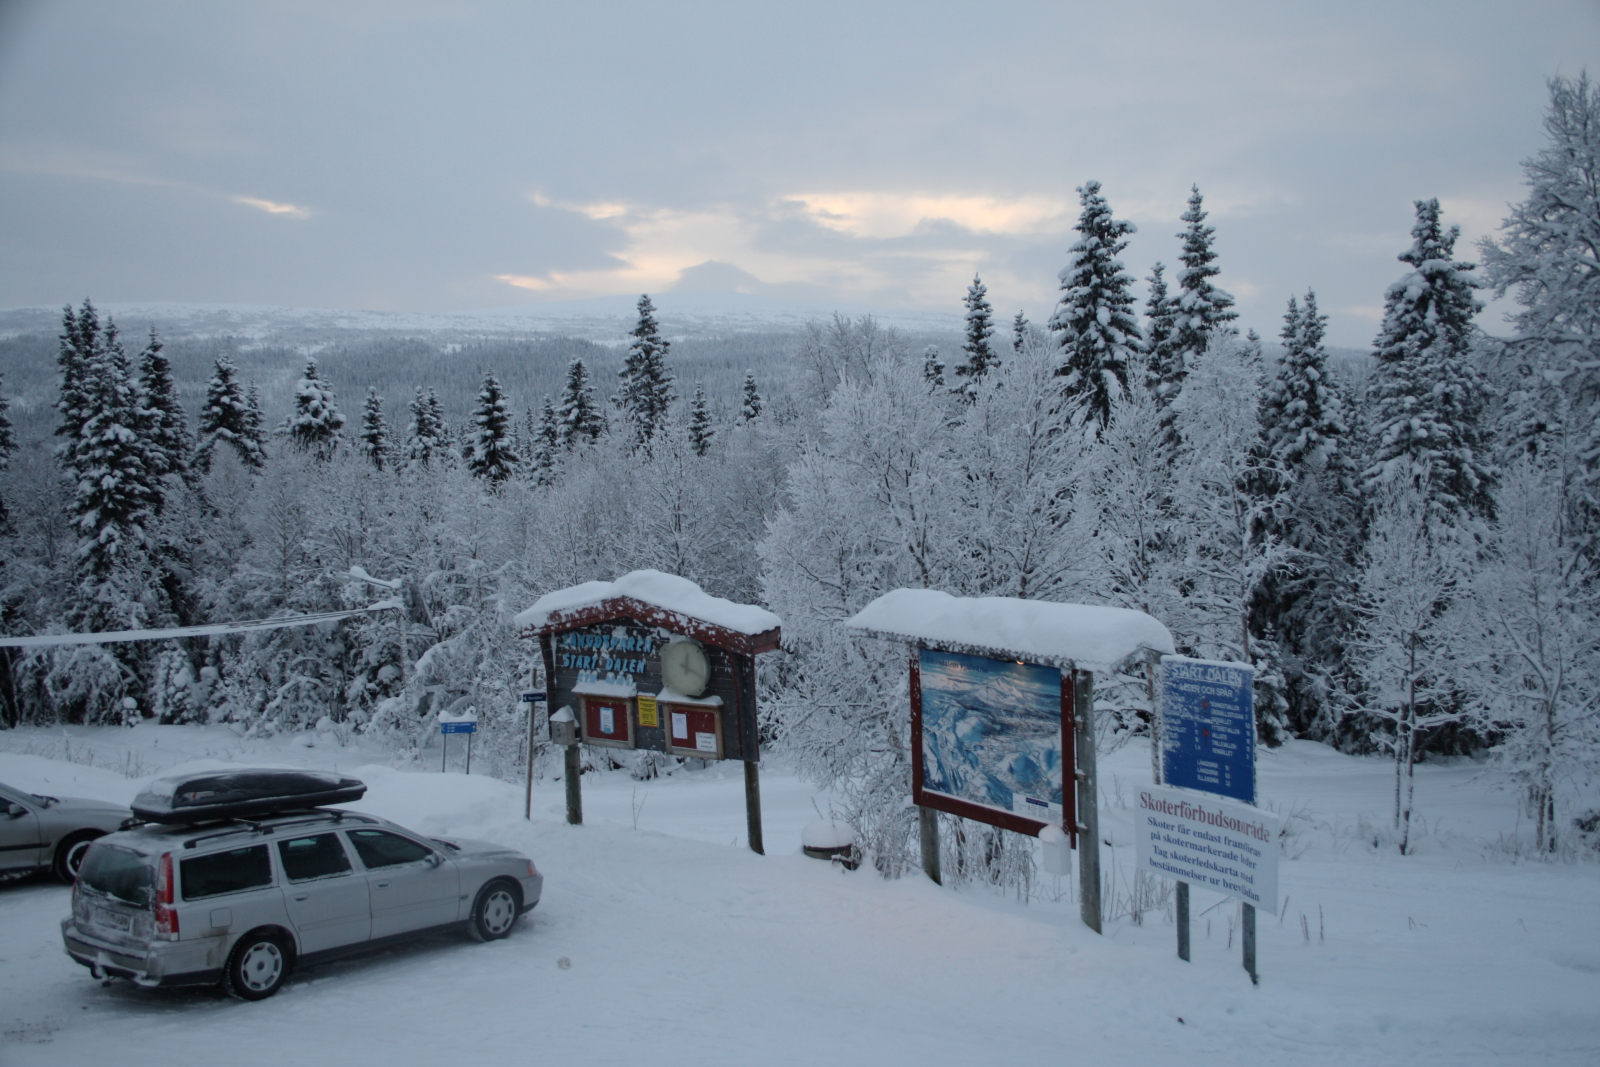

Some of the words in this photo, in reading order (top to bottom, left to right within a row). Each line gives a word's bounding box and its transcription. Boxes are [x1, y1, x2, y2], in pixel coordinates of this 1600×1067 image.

[563, 652, 598, 669] START
[605, 657, 645, 674] DALEN
[1171, 664, 1204, 680] START
[1206, 666, 1242, 686] DALEN
[1201, 685, 1215, 694] OCH
[1216, 687, 1233, 697] SPÅR
[1139, 791, 1270, 842] Skoterförbudsområde
[1147, 816, 1175, 831] Skoter
[1177, 823, 1191, 836] får
[1192, 829, 1222, 844] endast
[1223, 836, 1262, 857] framföras
[1150, 831, 1161, 842] på
[1162, 834, 1239, 861] skotermarkerade
[1152, 844, 1168, 859] Tag
[1169, 852, 1239, 877] skoterledskarta
[1149, 857, 1207, 882] bestämmelser
[1209, 876, 1221, 886] ur
[1222, 878, 1260, 902] brevlådan
